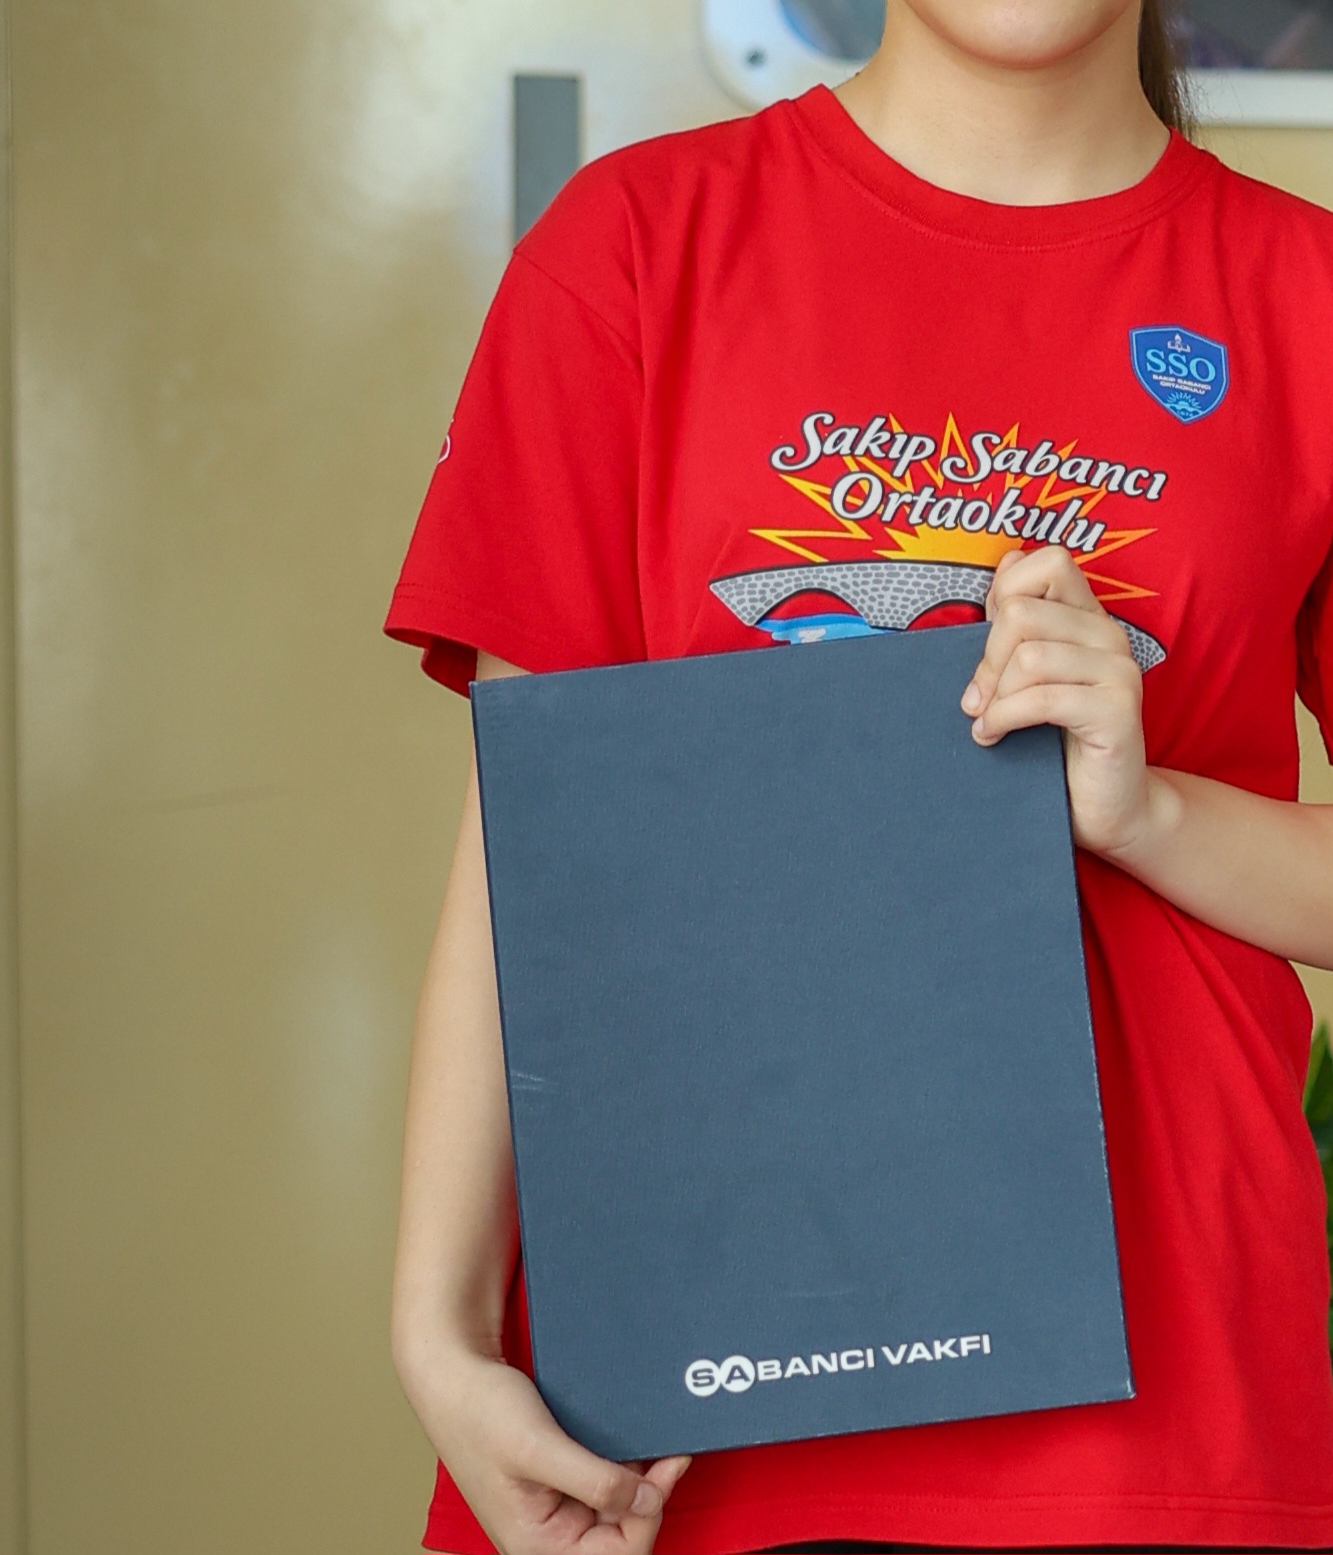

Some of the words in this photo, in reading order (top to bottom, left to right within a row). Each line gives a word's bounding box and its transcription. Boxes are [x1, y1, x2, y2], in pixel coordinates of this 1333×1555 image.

[1145, 348, 1216, 383] SSO
[770, 412, 936, 478] Sakıp
[941, 431, 1168, 501] Sabancı
[830, 471, 1109, 553] Ortaokulu
[685, 1348, 875, 1397] SABANCI
[881, 1334, 991, 1366] VAKFI
